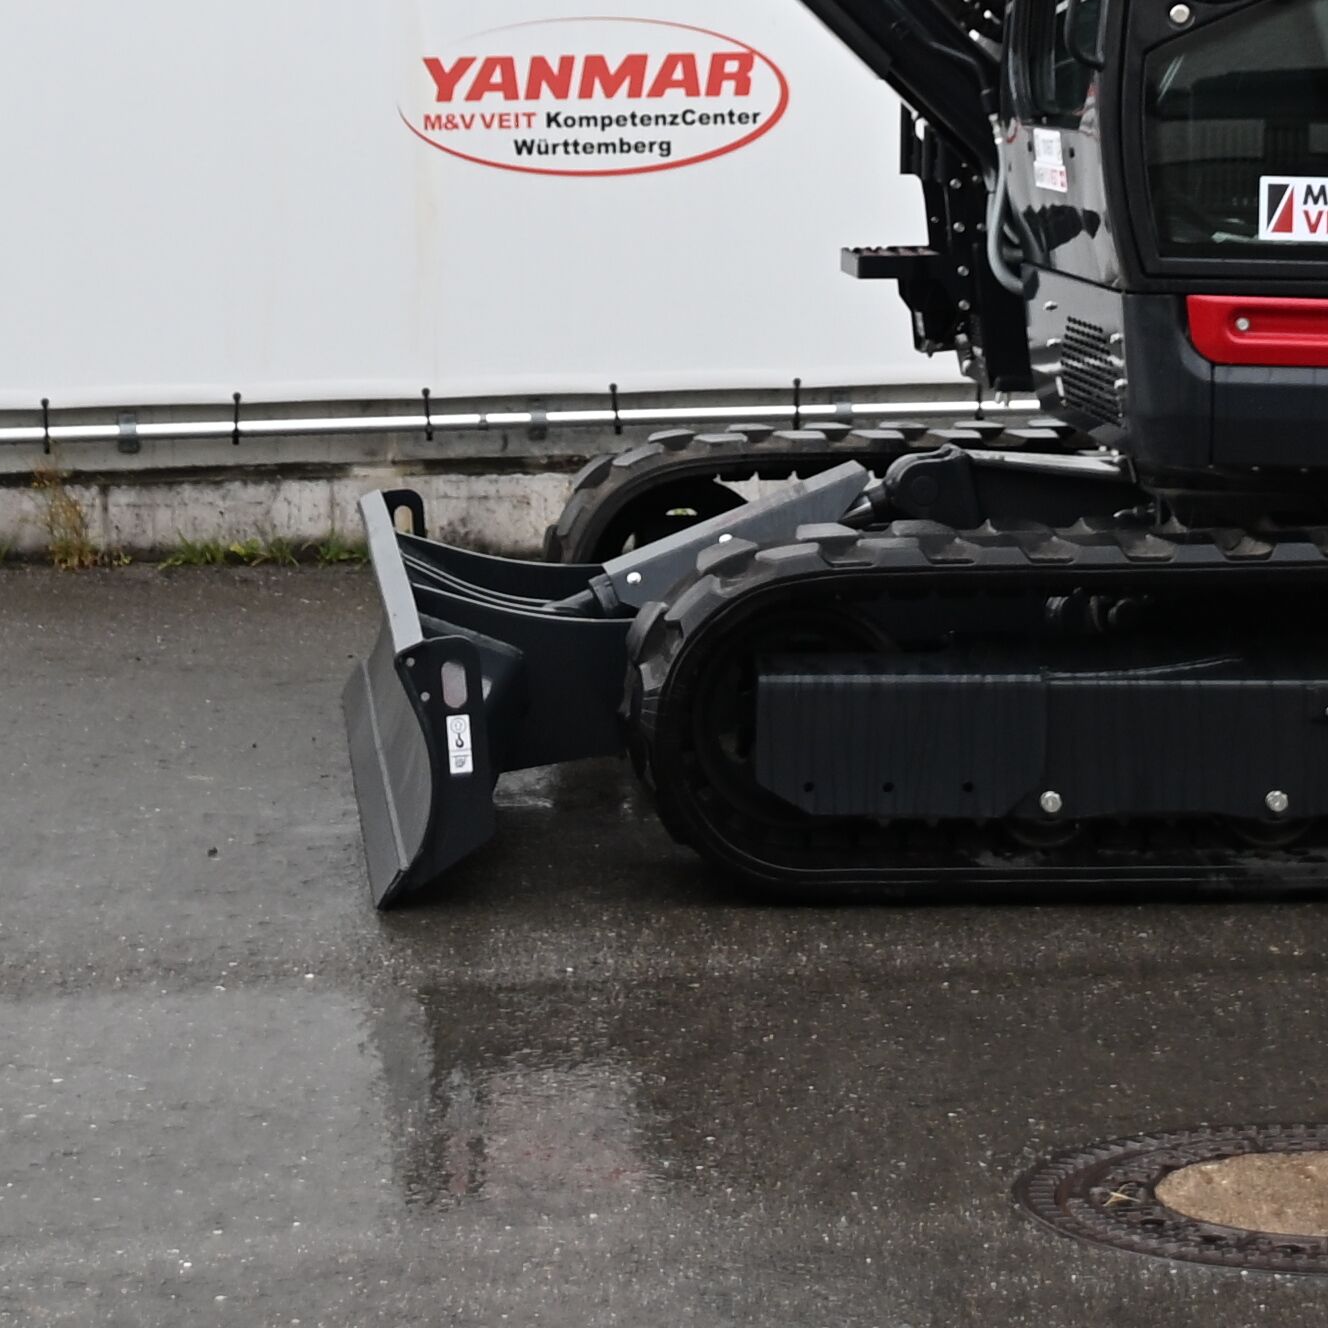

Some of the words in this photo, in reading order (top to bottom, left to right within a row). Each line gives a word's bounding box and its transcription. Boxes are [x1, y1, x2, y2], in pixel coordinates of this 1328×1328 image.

[423, 52, 756, 102] YANMAR
[424, 114, 476, 131] M&V
[482, 114, 536, 129] VEIT
[546, 108, 761, 131] KompetenzCenter
[513, 135, 672, 158] Württemberg
